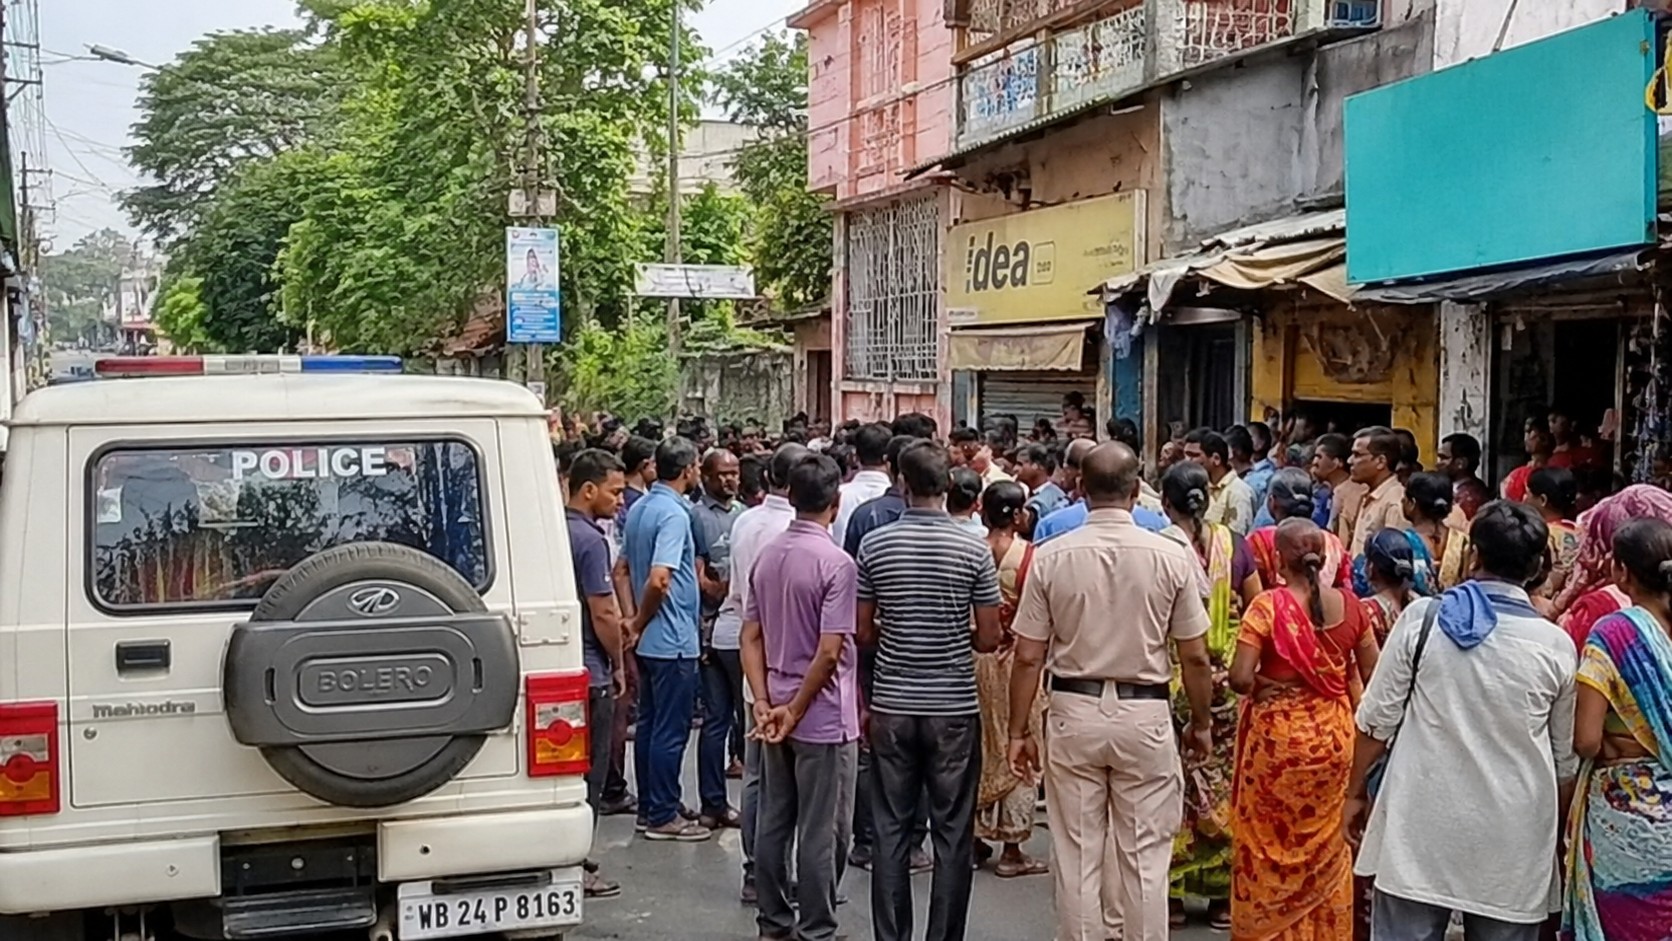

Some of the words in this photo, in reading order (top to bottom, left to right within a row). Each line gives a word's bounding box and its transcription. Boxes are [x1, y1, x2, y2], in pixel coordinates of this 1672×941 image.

[965, 231, 1030, 294] idea
[231, 447, 387, 481] POLICE
[318, 665, 433, 692] BOLERO
[418, 903, 449, 930] WB
[457, 899, 487, 926] 24
[494, 897, 508, 922] P
[516, 891, 575, 920] 8163
